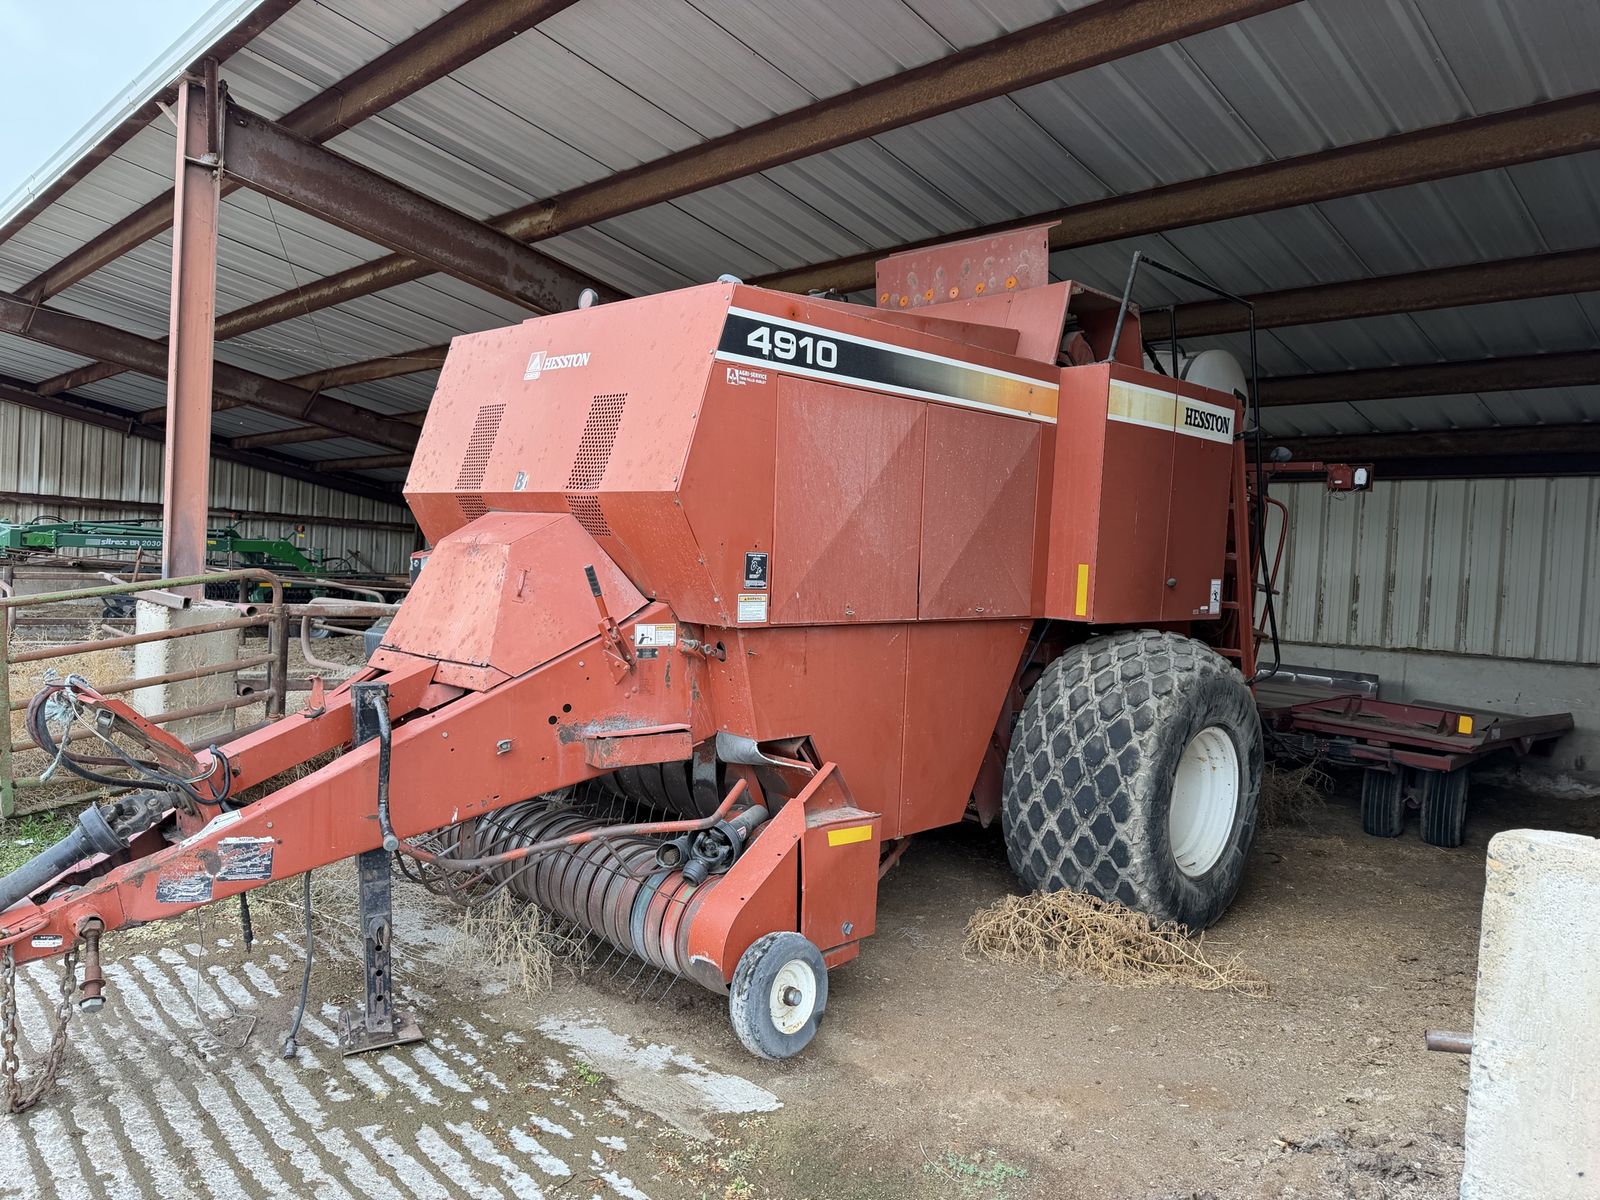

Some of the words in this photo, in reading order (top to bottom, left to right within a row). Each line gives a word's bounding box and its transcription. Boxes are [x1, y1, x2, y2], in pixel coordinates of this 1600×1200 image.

[747, 326, 837, 369] 4910
[542, 352, 591, 371] HESSTON
[1184, 407, 1230, 434] HESSTON
